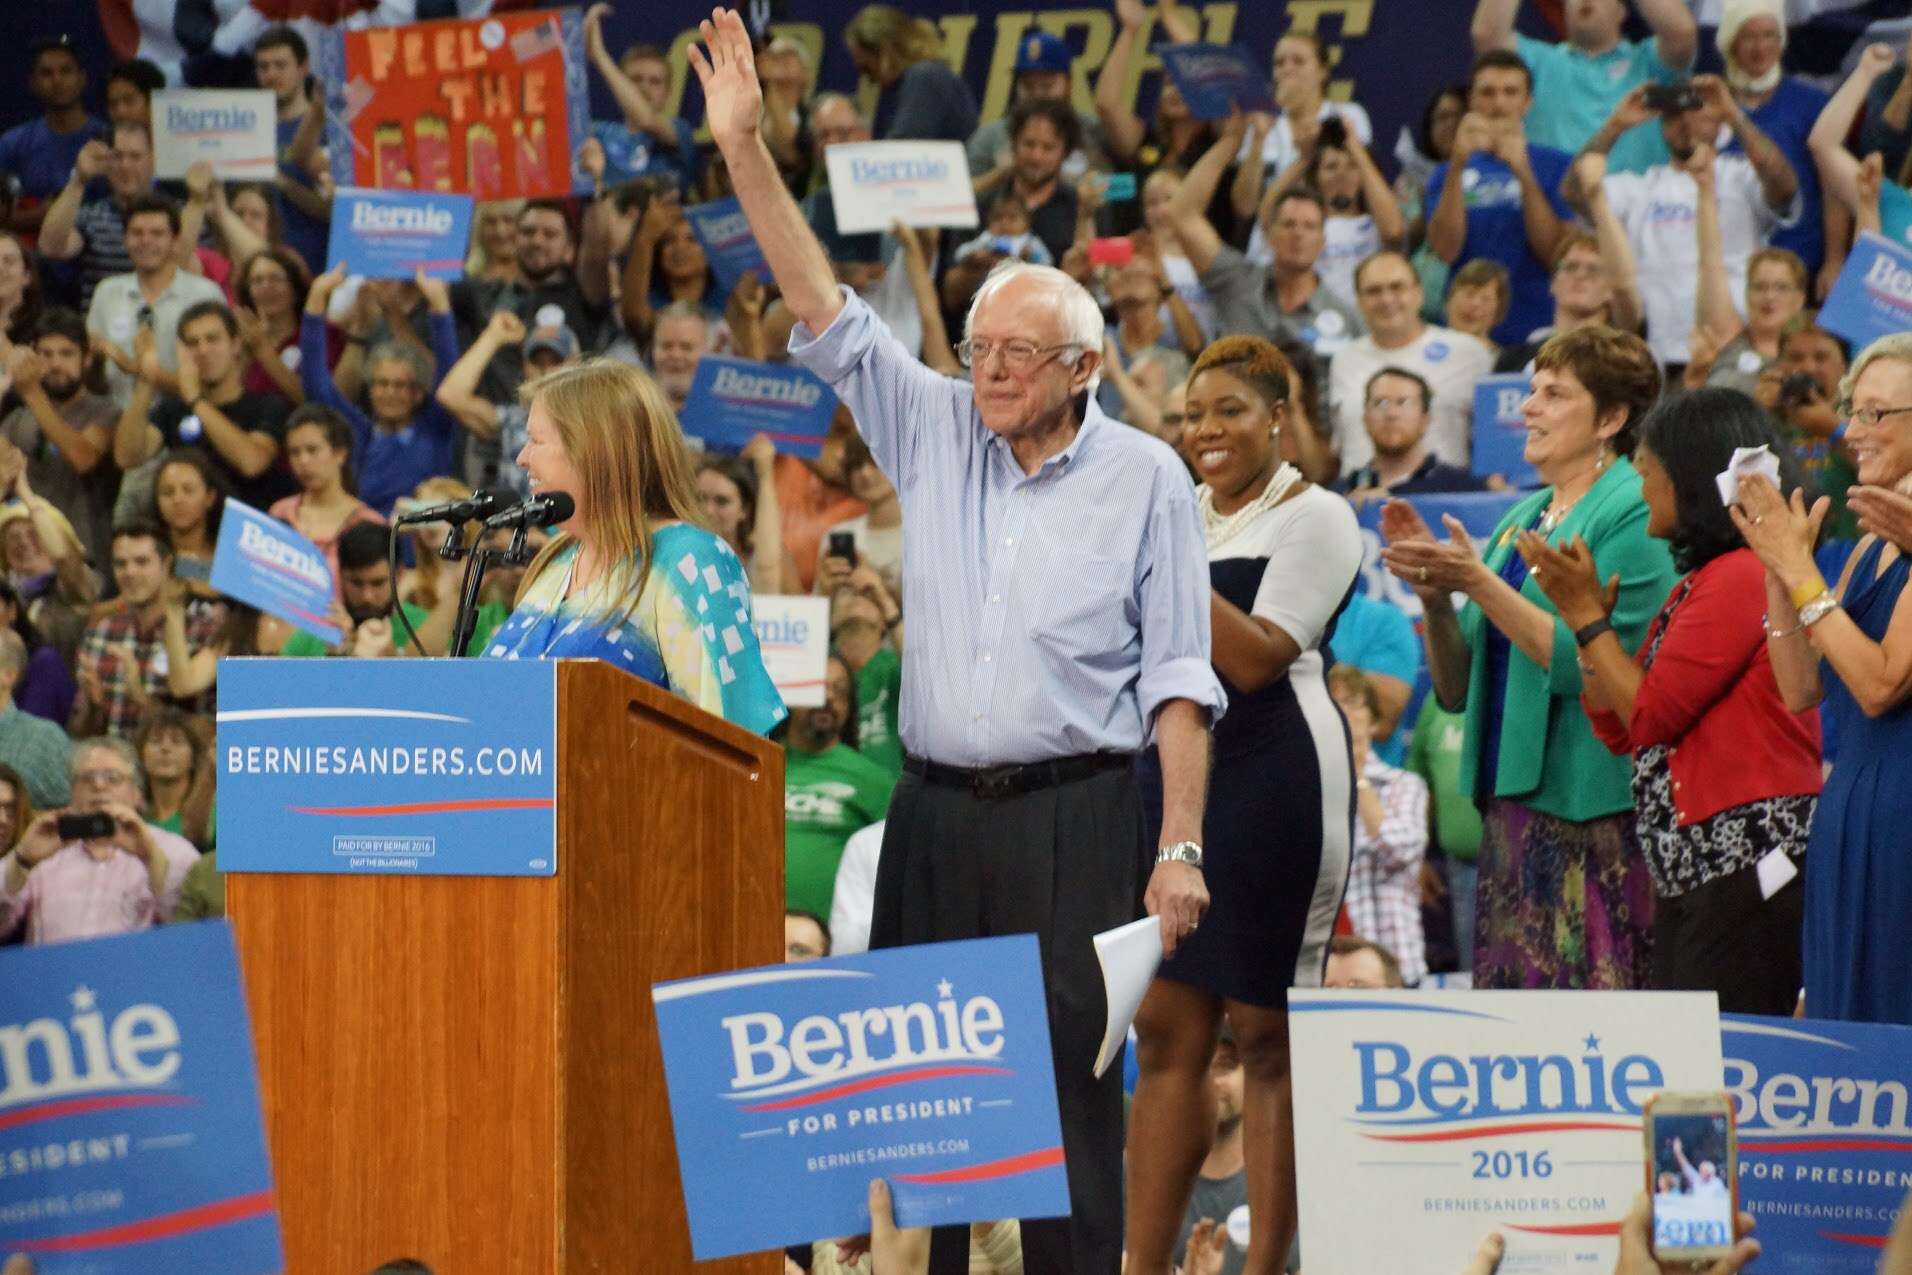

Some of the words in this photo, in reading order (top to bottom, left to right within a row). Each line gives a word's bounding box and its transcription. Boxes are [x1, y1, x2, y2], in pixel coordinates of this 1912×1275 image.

[367, 27, 488, 81] FEEL
[440, 70, 546, 121] THE
[167, 104, 257, 131] Bernie
[851, 154, 948, 185] Bernie
[352, 201, 454, 234] Bernie
[712, 367, 821, 407] Bernie
[227, 745, 543, 776] BERNIESANDERS.COM
[338, 839, 355, 851] PAID
[412, 839, 430, 852] 2016
[720, 977, 1006, 1089] Bernie
[1352, 1031, 1665, 1118] Bernie
[1721, 1056, 1912, 1130] Bern
[786, 1112, 838, 1137] FOR
[847, 1096, 974, 1128] PRESIDENT
[806, 1138, 971, 1172] BERNIESANDERS.COM
[1471, 1149, 1554, 1179] 2016
[1738, 1161, 1785, 1181] FOR
[1423, 1197, 1607, 1213] BERNIESANDERS.COM
[1654, 1218, 1728, 1247] ern
